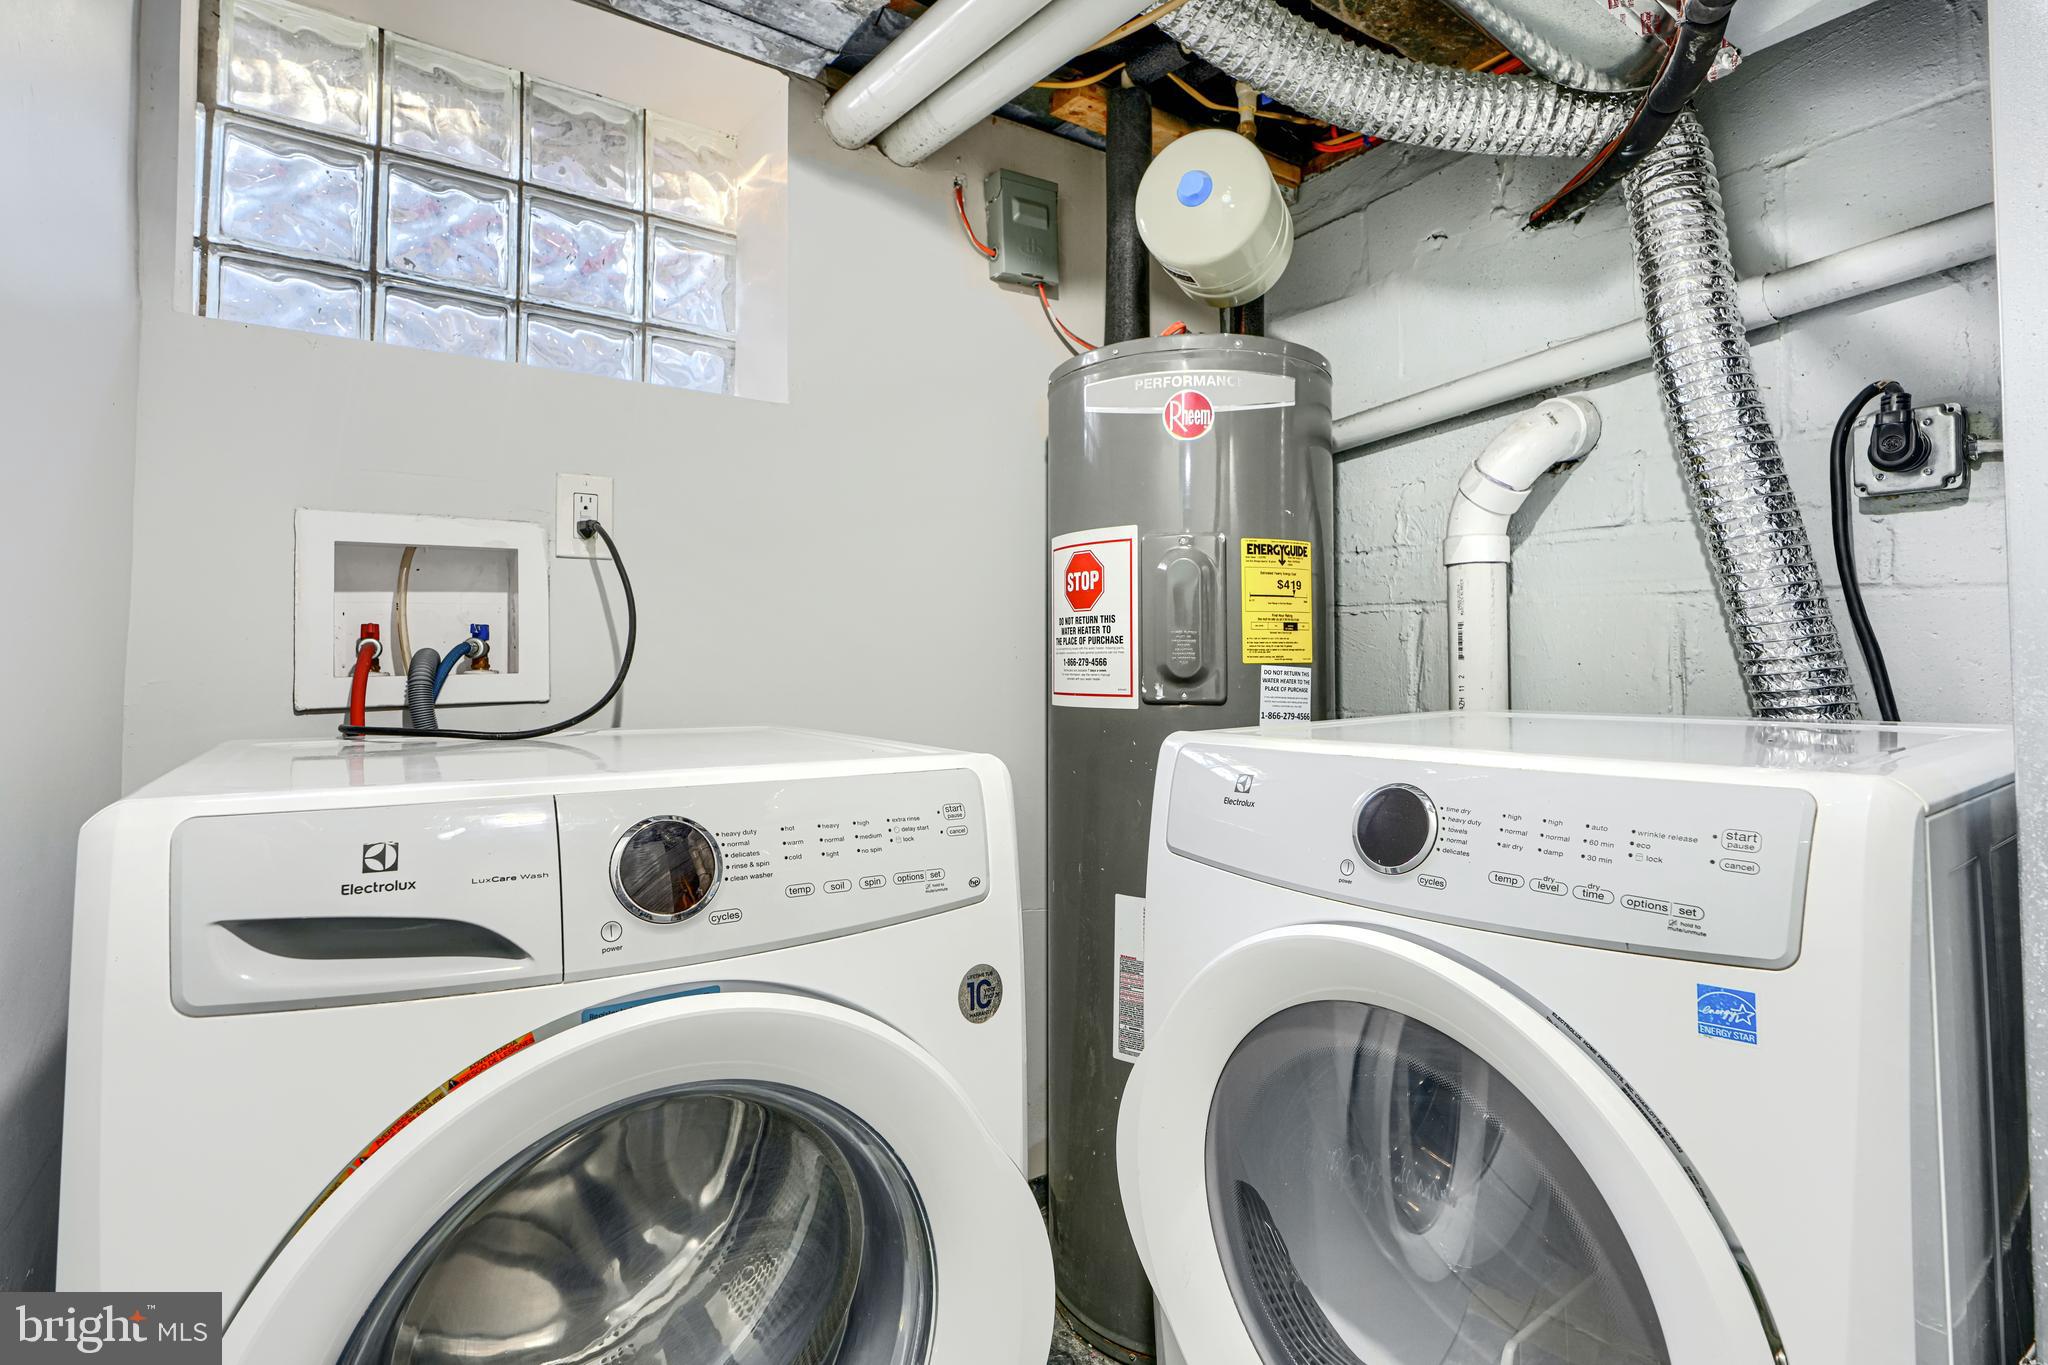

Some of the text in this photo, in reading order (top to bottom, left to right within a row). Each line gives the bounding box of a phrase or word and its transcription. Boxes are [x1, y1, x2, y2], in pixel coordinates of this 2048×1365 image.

[1169, 392, 1210, 432] Rheem
[1246, 544, 1308, 557] ENERGYGUIDE
[1067, 570, 1100, 592] STOP
[1059, 614, 1116, 626] DO NOT RETURN THIS
[1061, 625, 1111, 635] WATER HEATER TO
[1062, 637, 1078, 645] PLACE
[1079, 637, 1086, 645] OF
[1088, 635, 1124, 645] PURCHASE
[1063, 658, 1108, 666] 1-866-279-4566
[1261, 712, 1310, 720] 1-866-279-4566
[1224, 797, 1255, 807] Electrolux
[945, 804, 962, 813] start
[1448, 816, 1466, 825] heavy
[1508, 813, 1522, 822] high
[1548, 818, 1563, 827] high
[1448, 827, 1468, 835] towels
[1505, 828, 1528, 837] normal
[1592, 824, 1608, 832] auto
[1446, 837, 1468, 845] normal
[1545, 833, 1570, 843] normal
[1637, 829, 1698, 843] wrinkle release
[1726, 831, 1758, 843] start
[1442, 847, 1470, 857] delicates
[1512, 843, 1523, 852] dry
[1727, 843, 1754, 852] pause
[1543, 848, 1564, 858] damp
[1587, 854, 1597, 862] 30
[1646, 854, 1663, 863] lock
[1724, 862, 1755, 872] cancel
[471, 871, 549, 885] LuxCare Wash
[730, 872, 774, 882] clean washer
[897, 873, 924, 882] options
[1419, 876, 1444, 888] cycles
[1494, 873, 1518, 886] temp
[341, 879, 416, 896] Electrolux
[830, 882, 845, 890] soil
[864, 878, 881, 887] spin
[1537, 881, 1560, 892] level
[789, 886, 811, 895] temp
[1582, 889, 1604, 900] time
[1626, 898, 1697, 917] options set
[711, 911, 740, 922] cycles
[602, 946, 623, 954] power
[1702, 1004, 1737, 1022] energy
[1552, 1012, 1582, 1040] ELECTROLUX
[1583, 1040, 1597, 1054] HOME
[1700, 1024, 1755, 1043] ENERGY STAR
